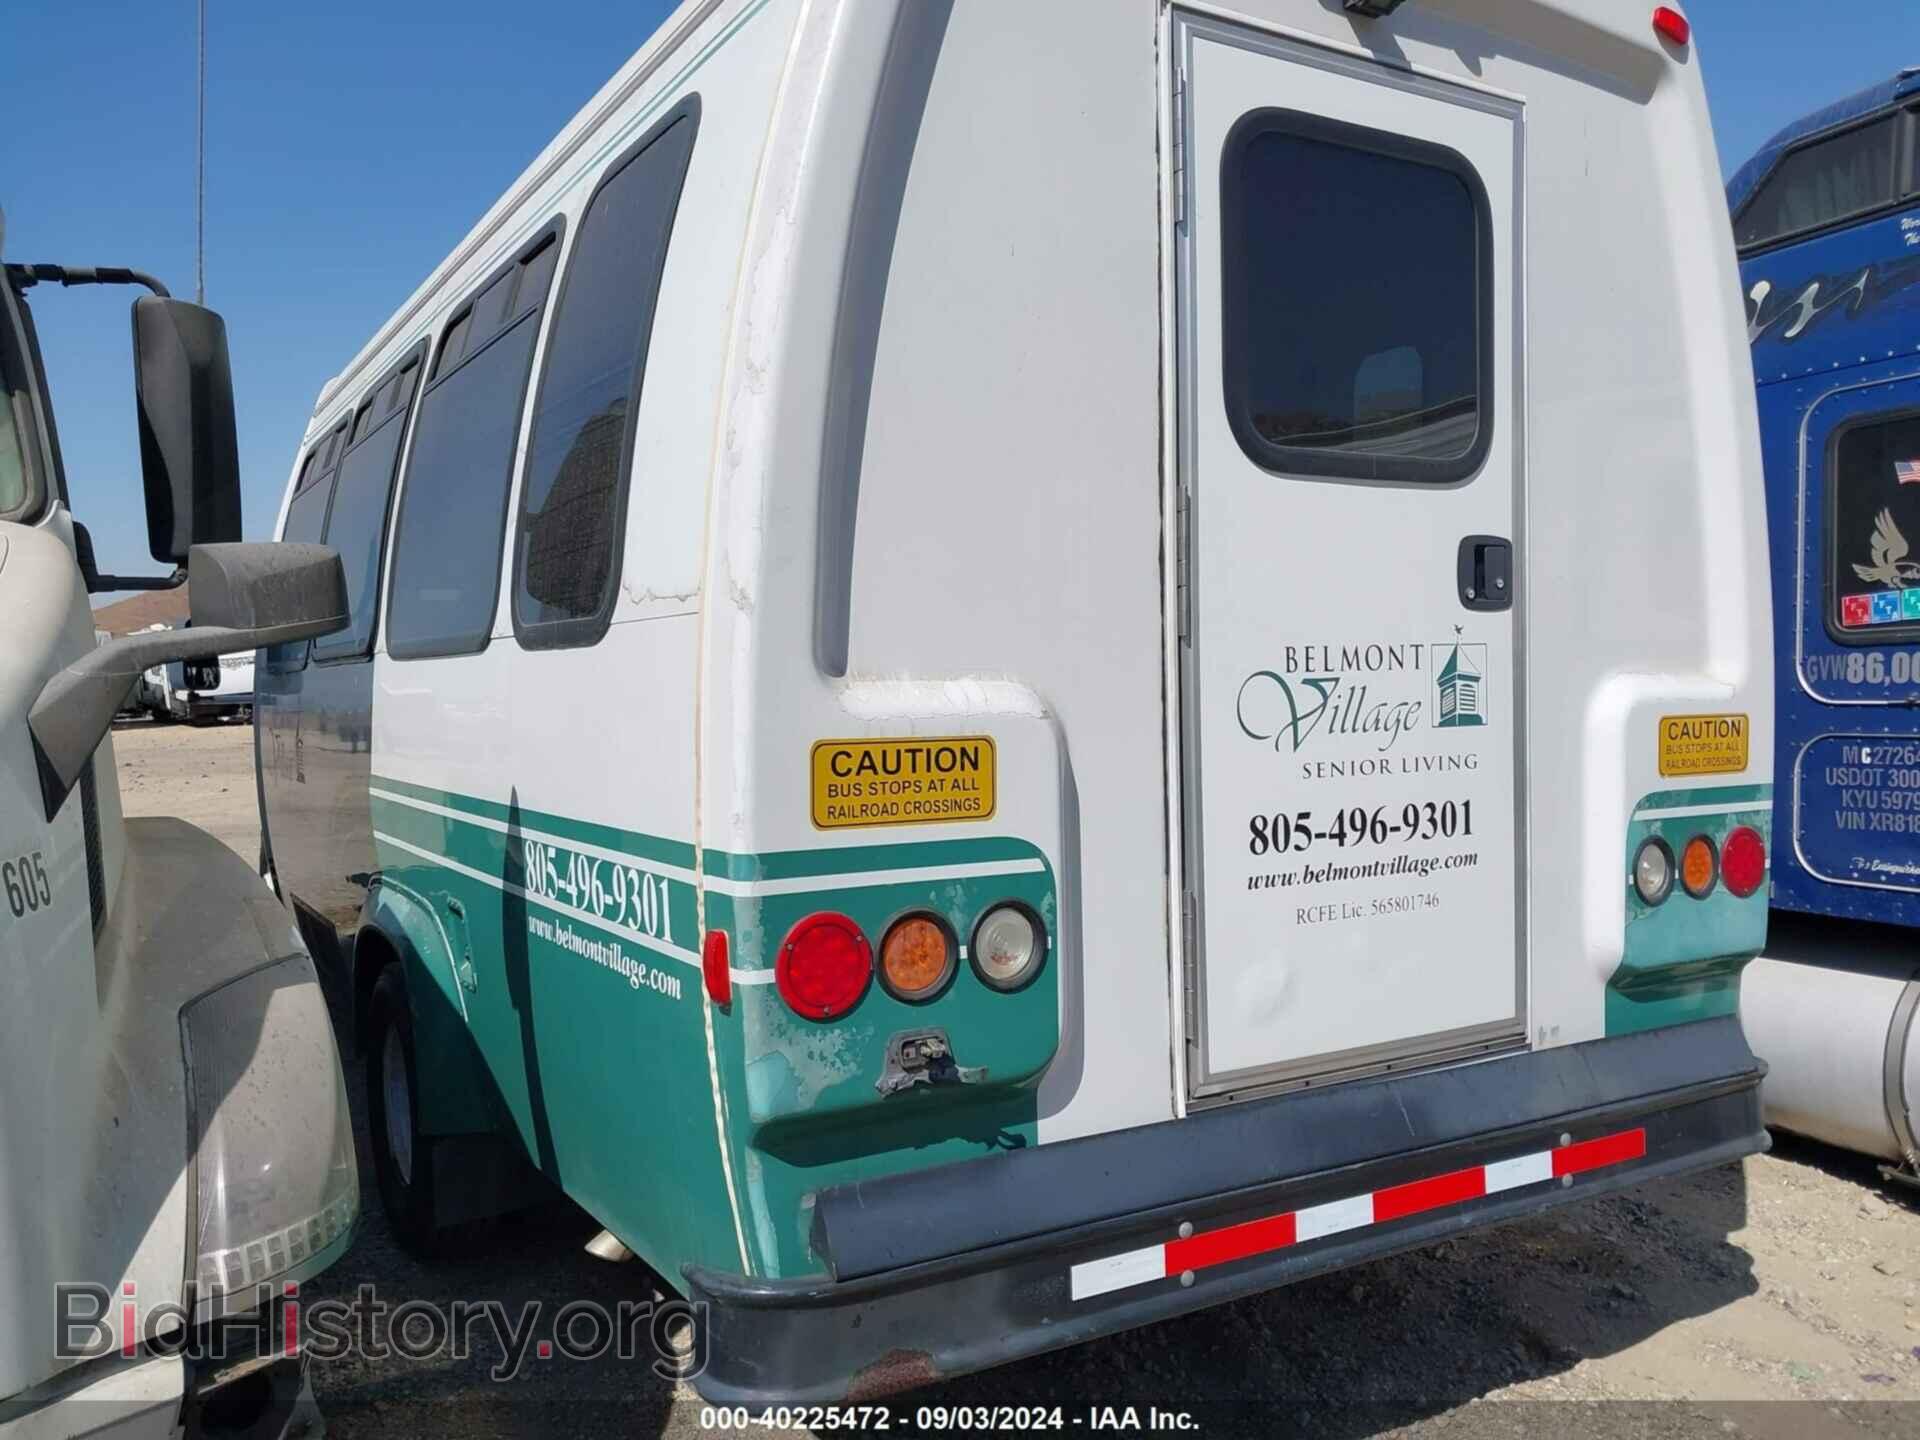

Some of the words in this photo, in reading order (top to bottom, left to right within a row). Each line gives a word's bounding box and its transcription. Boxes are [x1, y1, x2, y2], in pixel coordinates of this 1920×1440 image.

[1284, 643, 1425, 674] BELMONT
[1236, 669, 1422, 753] Village
[1668, 719, 1741, 741] CAUTION
[831, 746, 979, 778] CAUTION
[1303, 758, 1392, 779] SENIOR
[1402, 753, 1478, 774] LIVING
[1825, 767, 1884, 787] USDOT
[828, 783, 863, 799] BUS
[868, 779, 922, 795] STOPS
[927, 778, 946, 793] AT
[951, 778, 979, 792] ALL
[1842, 788, 1878, 809] KYU
[827, 802, 899, 820] RAILROAD
[903, 797, 981, 815] CROSSINGS
[1835, 810, 1866, 830] VIN
[1249, 799, 1473, 856] 805-496-9301
[2, 851, 52, 918] 605
[1247, 851, 1478, 890] www.belmontvillage.com
[525, 840, 674, 944] 805-496-9301
[1296, 904, 1337, 925] RCFE
[1342, 903, 1366, 919] Lic.
[1371, 891, 1440, 916] 565801746
[528, 914, 682, 1000] www.belmontvillage.com
